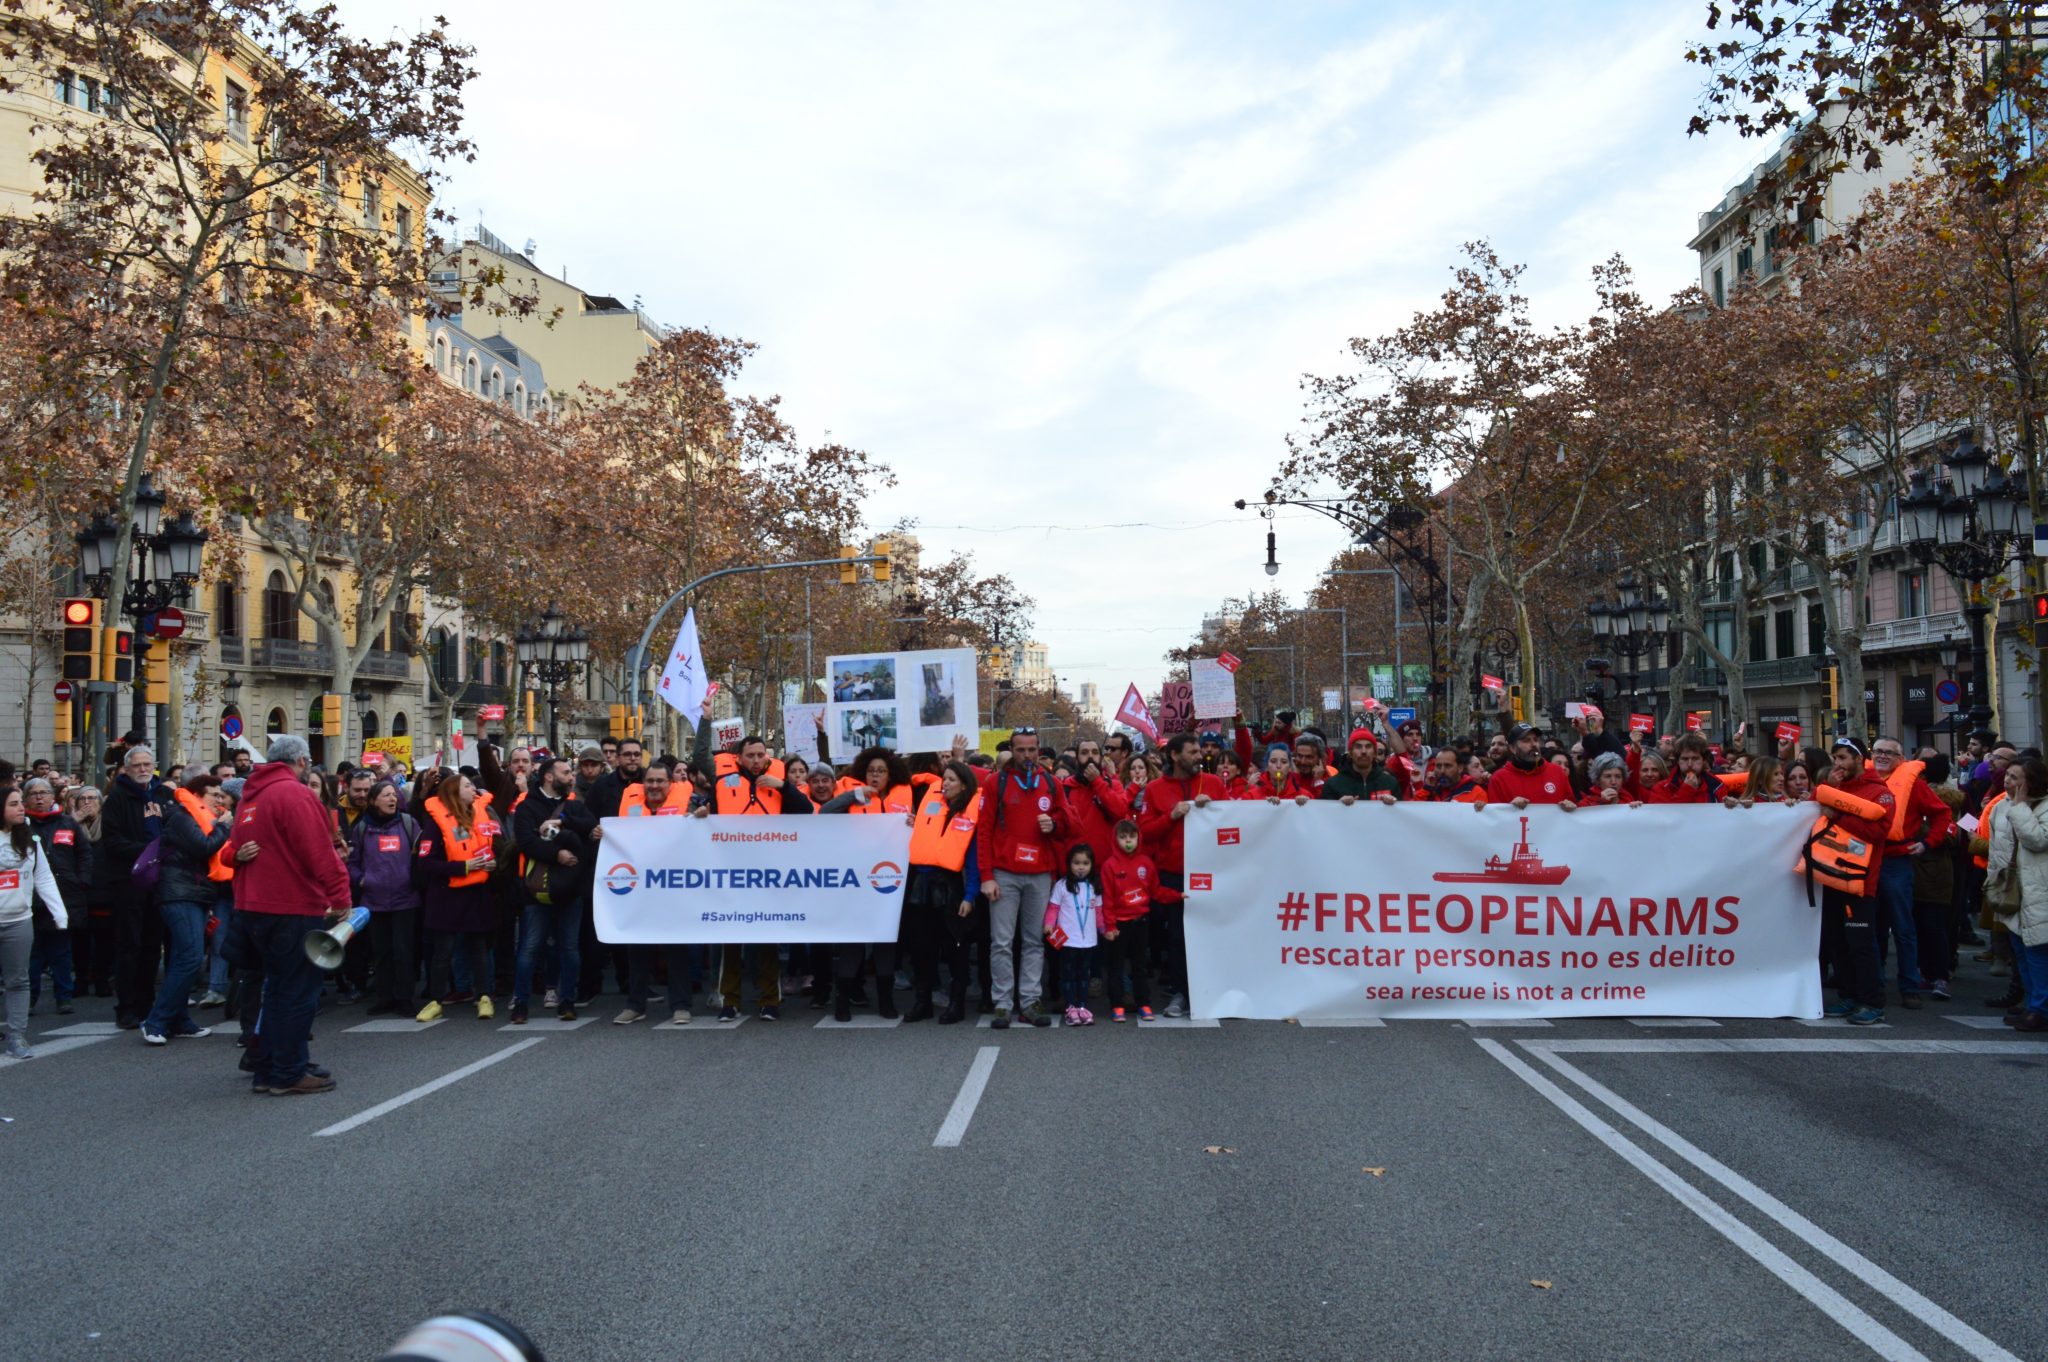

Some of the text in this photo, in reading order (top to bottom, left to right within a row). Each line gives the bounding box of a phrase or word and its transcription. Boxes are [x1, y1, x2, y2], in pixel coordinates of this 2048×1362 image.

[1373, 686, 1394, 699] ROIG
[1864, 690, 1875, 699] OSS
[1909, 688, 1926, 698] BOSS
[719, 727, 740, 741] FREE
[1834, 799, 1862, 815] OPEN
[711, 832, 798, 842] #United4Med
[645, 868, 861, 889] MEDITERRANEA
[701, 912, 806, 923] #SavingHumans
[1277, 892, 1740, 937] #FREEOPENARMS
[1281, 944, 1735, 974] rescatar personas no es delito
[1366, 982, 1646, 1000] sea rescue is not a crime
